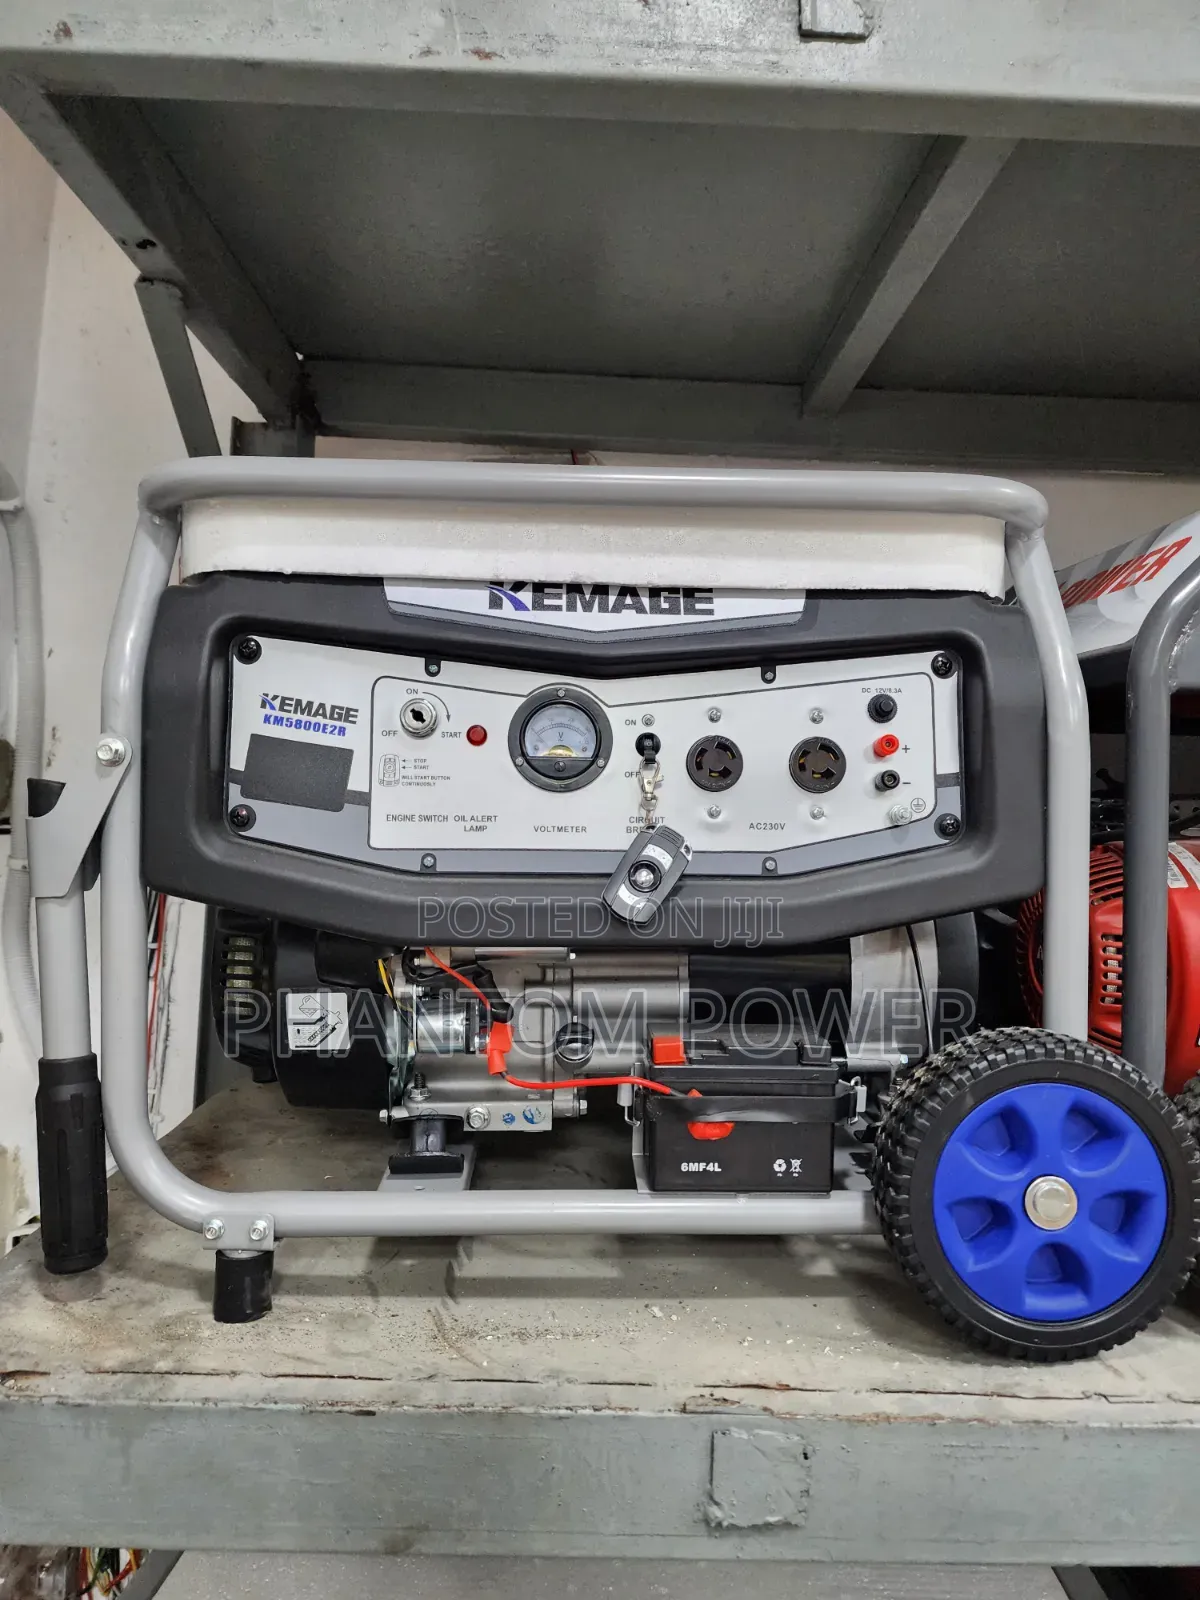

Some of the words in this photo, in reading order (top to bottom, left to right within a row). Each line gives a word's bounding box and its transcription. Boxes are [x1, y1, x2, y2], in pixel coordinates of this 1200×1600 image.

[485, 580, 715, 616] KEMAGE
[405, 687, 419, 695] ON
[259, 692, 359, 725] KEMAGE
[262, 713, 347, 737] KM5800E2R
[381, 729, 399, 737] OFF
[440, 731, 463, 739] START
[386, 814, 416, 822] ENGINE
[418, 814, 449, 822] SWITCH
[453, 814, 468, 823] OIL
[470, 814, 498, 823] ALERT
[463, 825, 488, 833] LAMP
[533, 825, 587, 833] VOLTMETER
[749, 822, 786, 830] AC230V
[680, 1162, 722, 1172] 6MF4L
